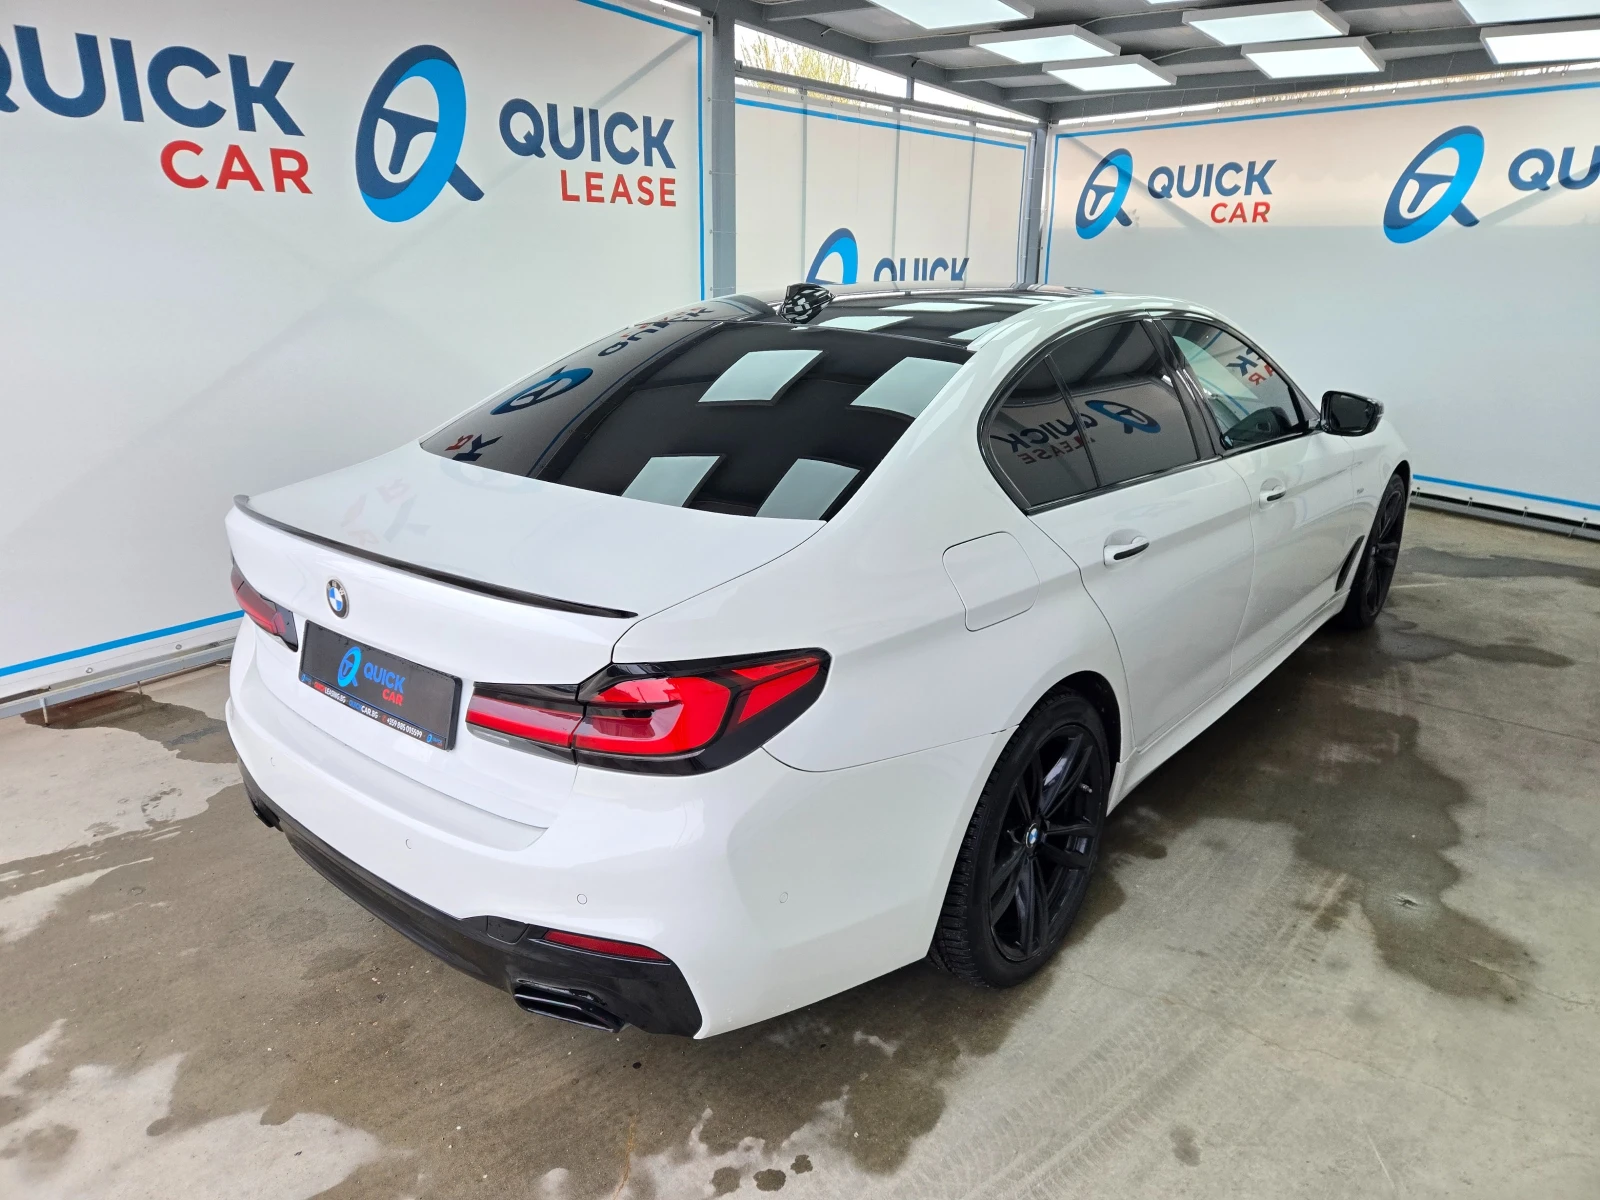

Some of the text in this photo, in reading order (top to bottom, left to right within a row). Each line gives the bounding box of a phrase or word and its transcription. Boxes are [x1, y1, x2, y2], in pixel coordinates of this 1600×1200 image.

[0, 24, 305, 137] UICK
[499, 98, 675, 169] QUICK
[160, 139, 313, 195] CAR
[1147, 159, 1277, 200] QUICK
[1508, 144, 1600, 191] QU
[560, 169, 677, 208] LEASE
[1208, 200, 1272, 225] CAR
[873, 257, 970, 282] QUICK
[364, 661, 406, 694] QUICK
[381, 688, 404, 706] CAR
